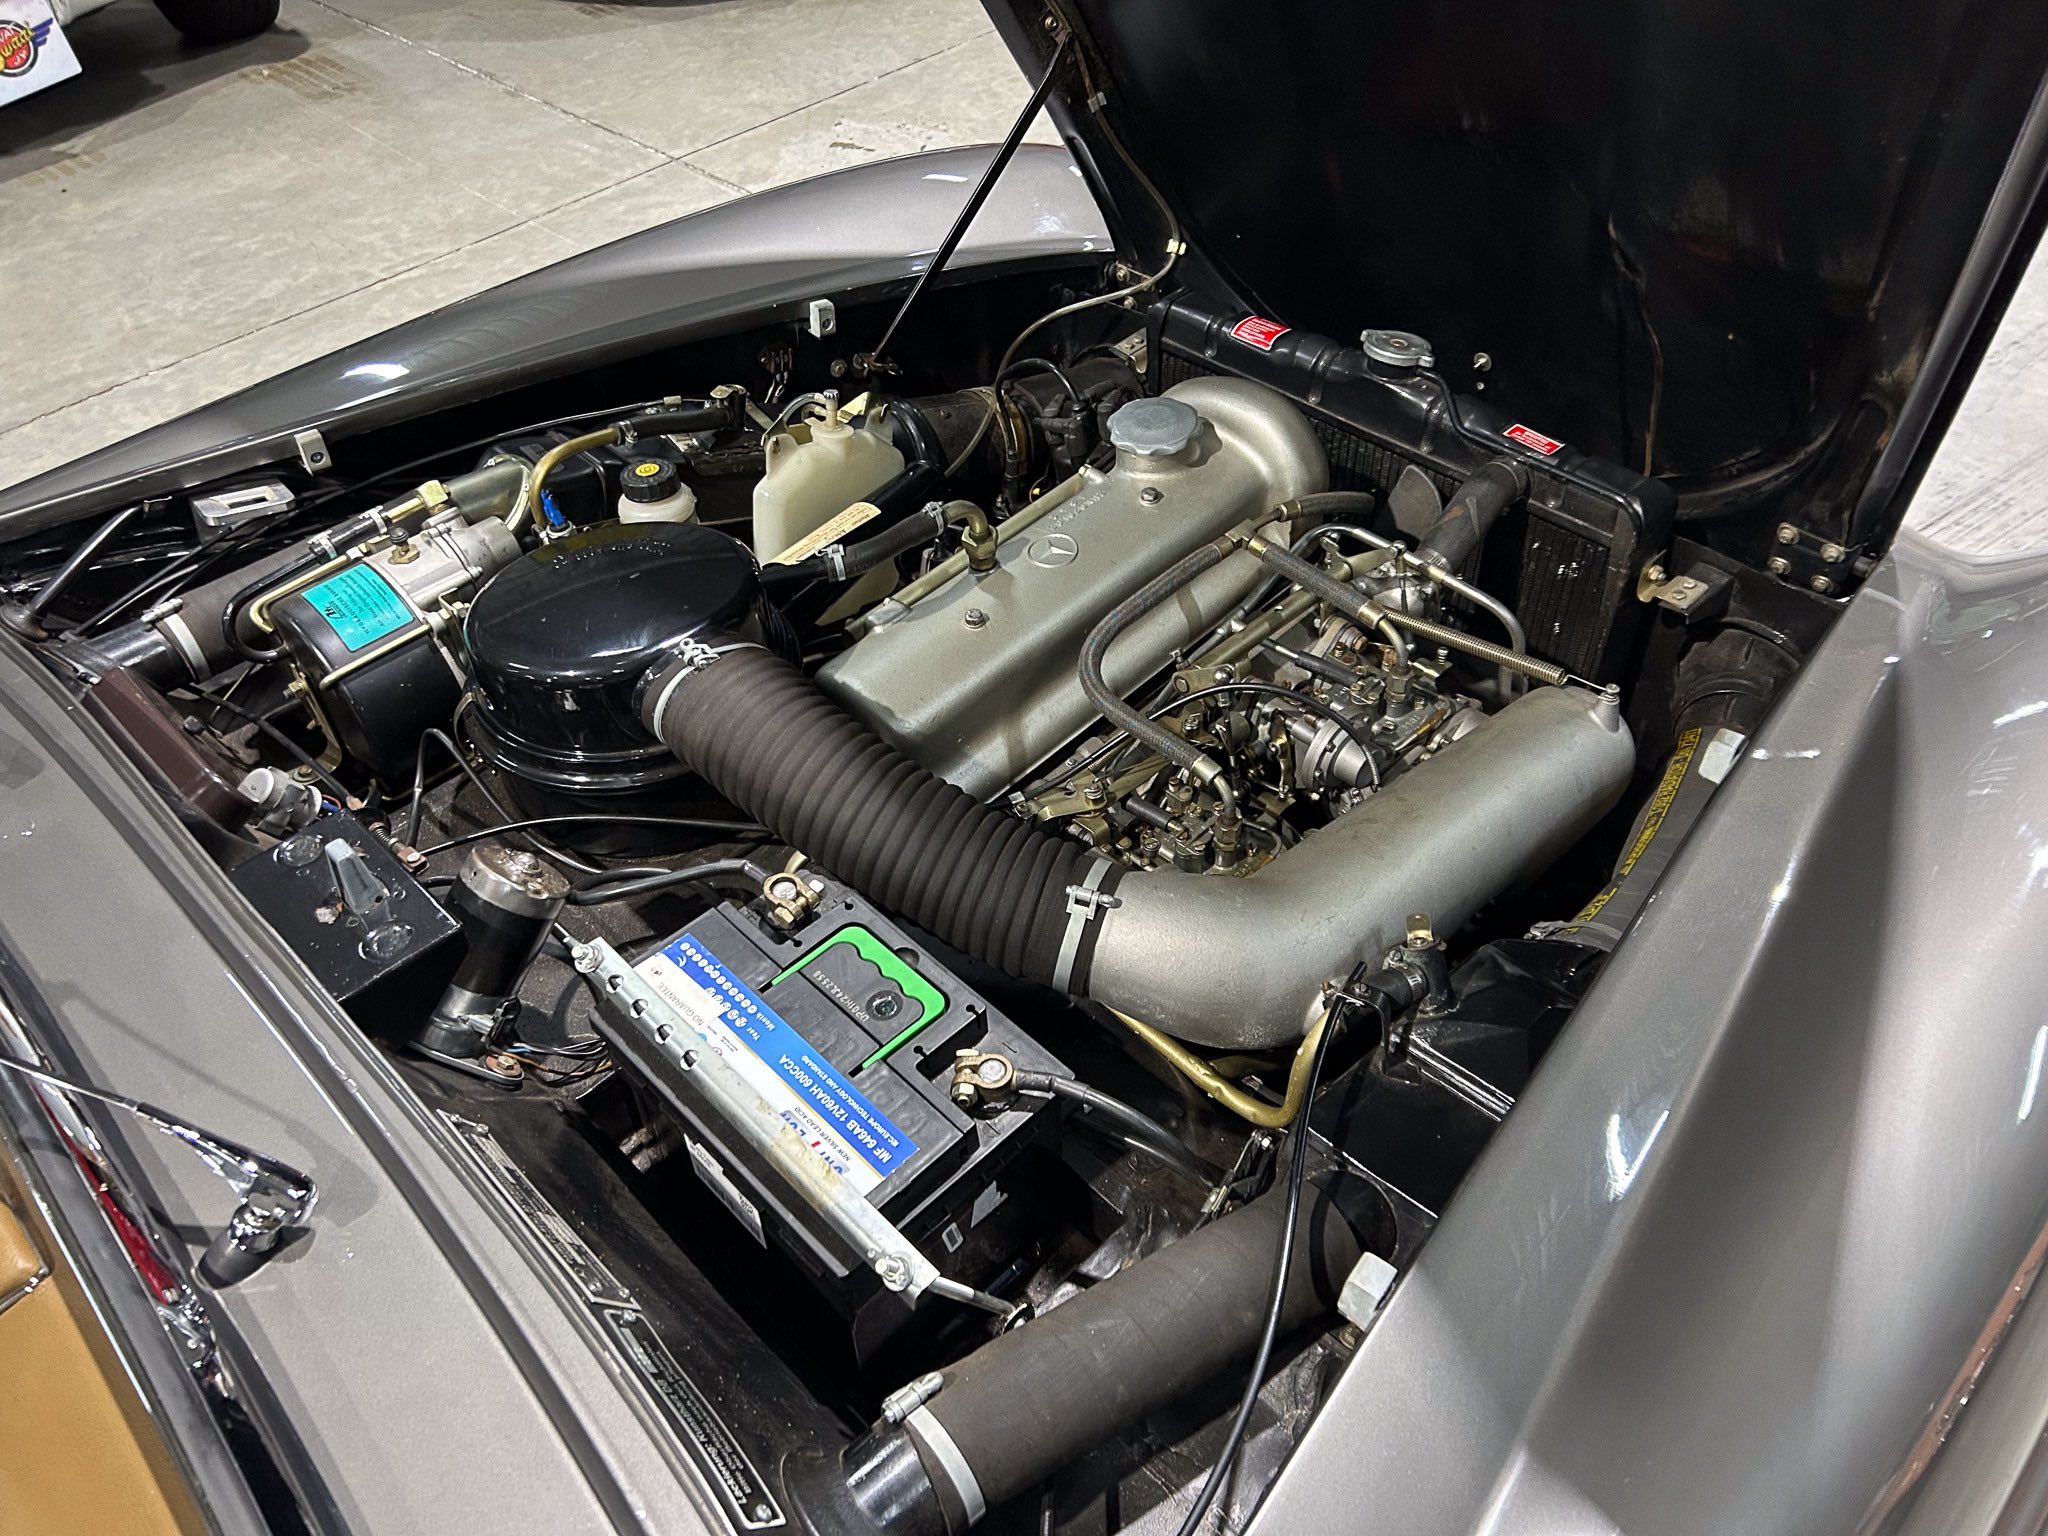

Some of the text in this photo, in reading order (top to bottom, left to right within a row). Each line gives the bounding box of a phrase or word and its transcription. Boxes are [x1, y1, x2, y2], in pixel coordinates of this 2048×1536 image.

[654, 981, 705, 1025] NO GUARANTEE
[744, 1026, 762, 1040] Year
[753, 1012, 776, 1030] Month
[775, 1053, 815, 1087] 600CCA
[799, 1054, 829, 1079] STANDARD
[824, 1077, 839, 1089] AND
[807, 1084, 850, 1121] 12V60AH
[834, 1086, 871, 1119] TECHNOLOGY
[793, 1106, 851, 1161] NEW SILVER LEAD ACID
[844, 1118, 878, 1149] 646AB
[872, 1145, 892, 1163] MF
